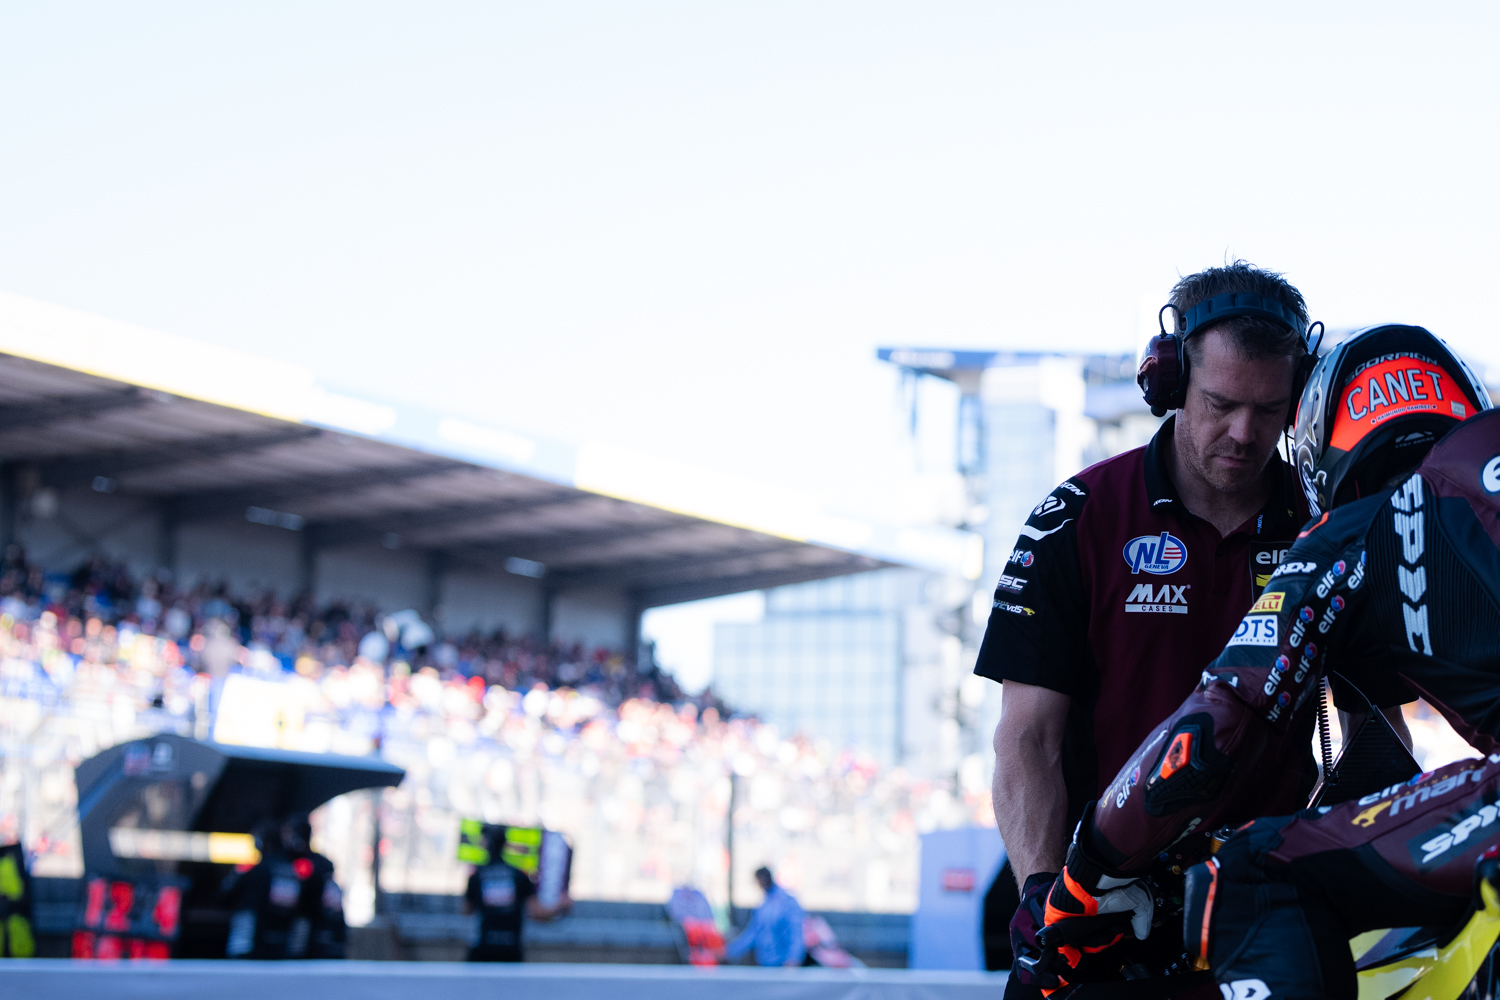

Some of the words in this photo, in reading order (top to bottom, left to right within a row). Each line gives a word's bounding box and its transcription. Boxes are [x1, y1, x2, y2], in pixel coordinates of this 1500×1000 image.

[1345, 352, 1438, 384] SCORPION
[1347, 369, 1442, 421] CANET
[1126, 583, 1187, 605] MAX
[1316, 571, 1335, 599] elf
[1141, 604, 1174, 613] CASES
[1318, 607, 1336, 635] elf
[1235, 618, 1276, 638] DTS
[1289, 618, 1309, 649] elf
[1264, 667, 1282, 697] elf
[1294, 655, 1311, 684] elf
[1116, 776, 1131, 809] elf
